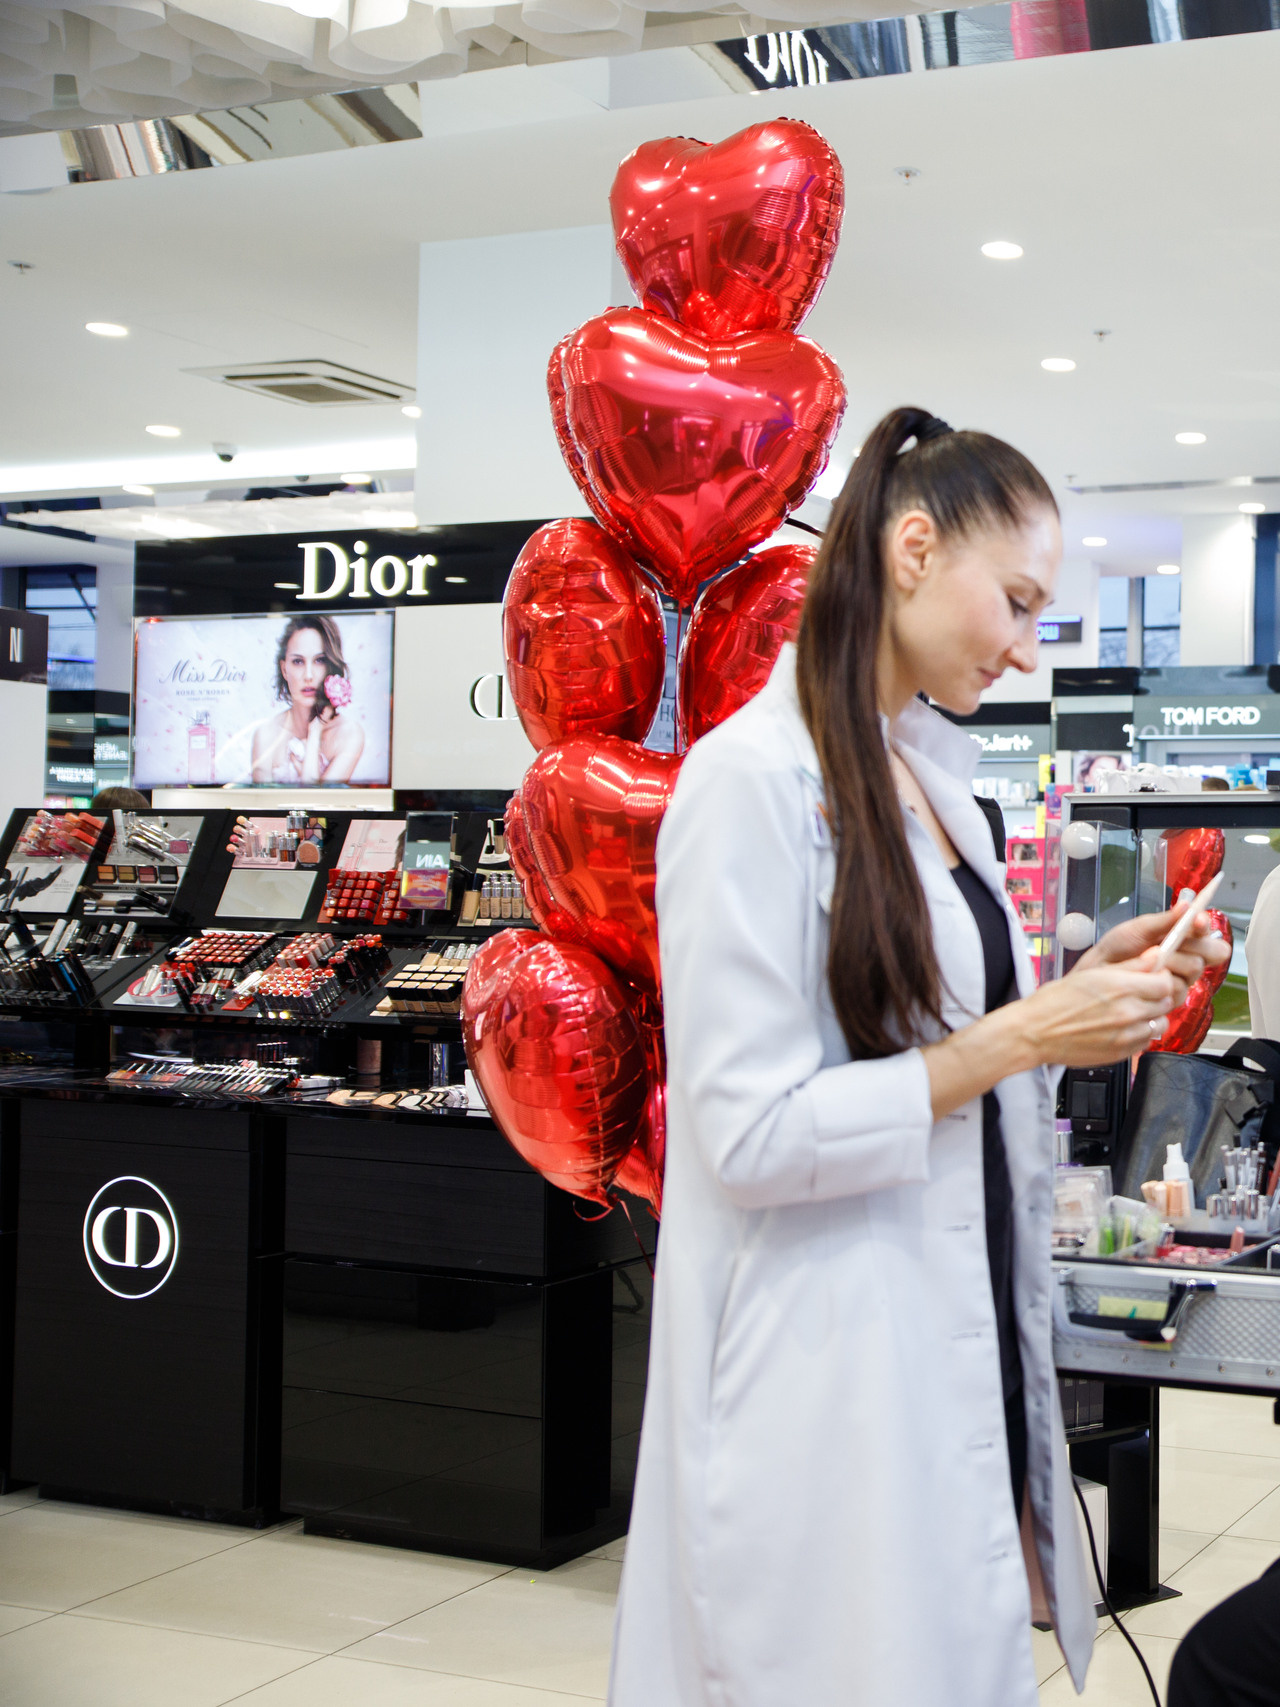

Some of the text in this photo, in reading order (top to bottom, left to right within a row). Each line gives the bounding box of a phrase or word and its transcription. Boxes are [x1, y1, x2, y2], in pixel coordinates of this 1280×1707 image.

[296, 540, 438, 600] Dior
[159, 659, 247, 684] Miss Dior
[1160, 706, 1261, 726] TOM FORD
